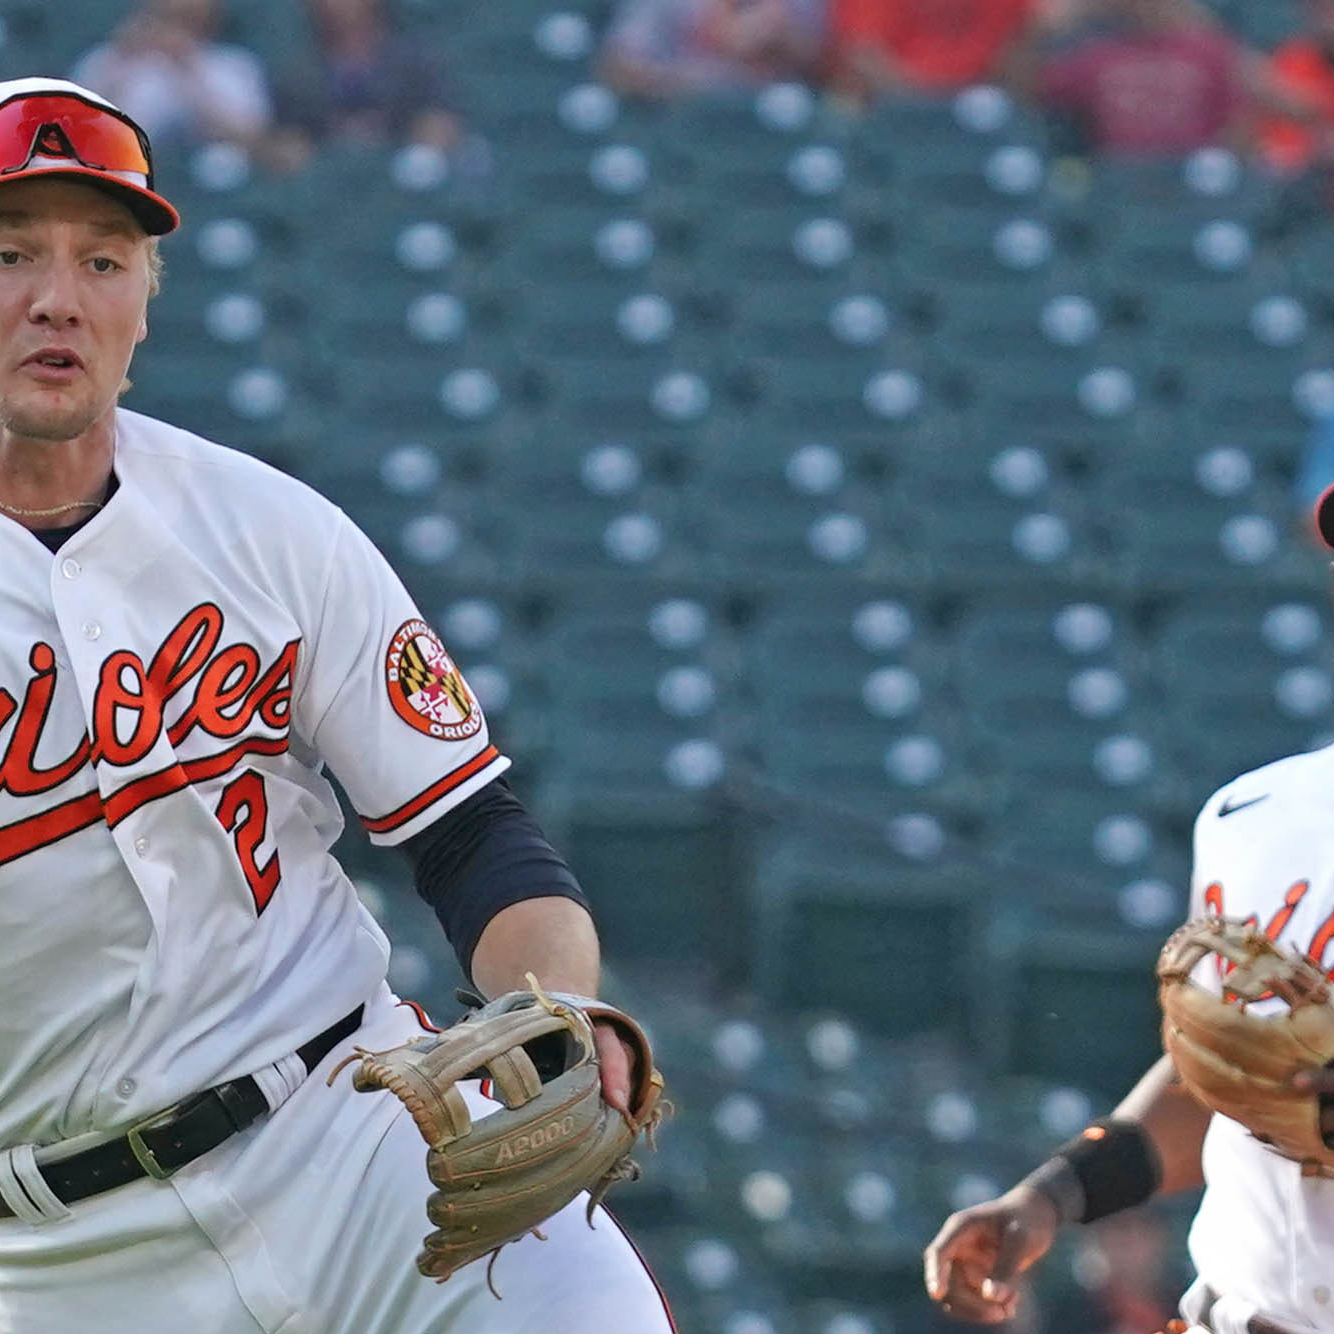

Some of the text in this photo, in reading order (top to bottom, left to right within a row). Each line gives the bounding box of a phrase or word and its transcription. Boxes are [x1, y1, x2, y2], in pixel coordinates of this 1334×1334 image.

[388, 621, 445, 681] BALTIMO
[214, 768, 281, 918] 2
[495, 1115, 575, 1165] A2000
